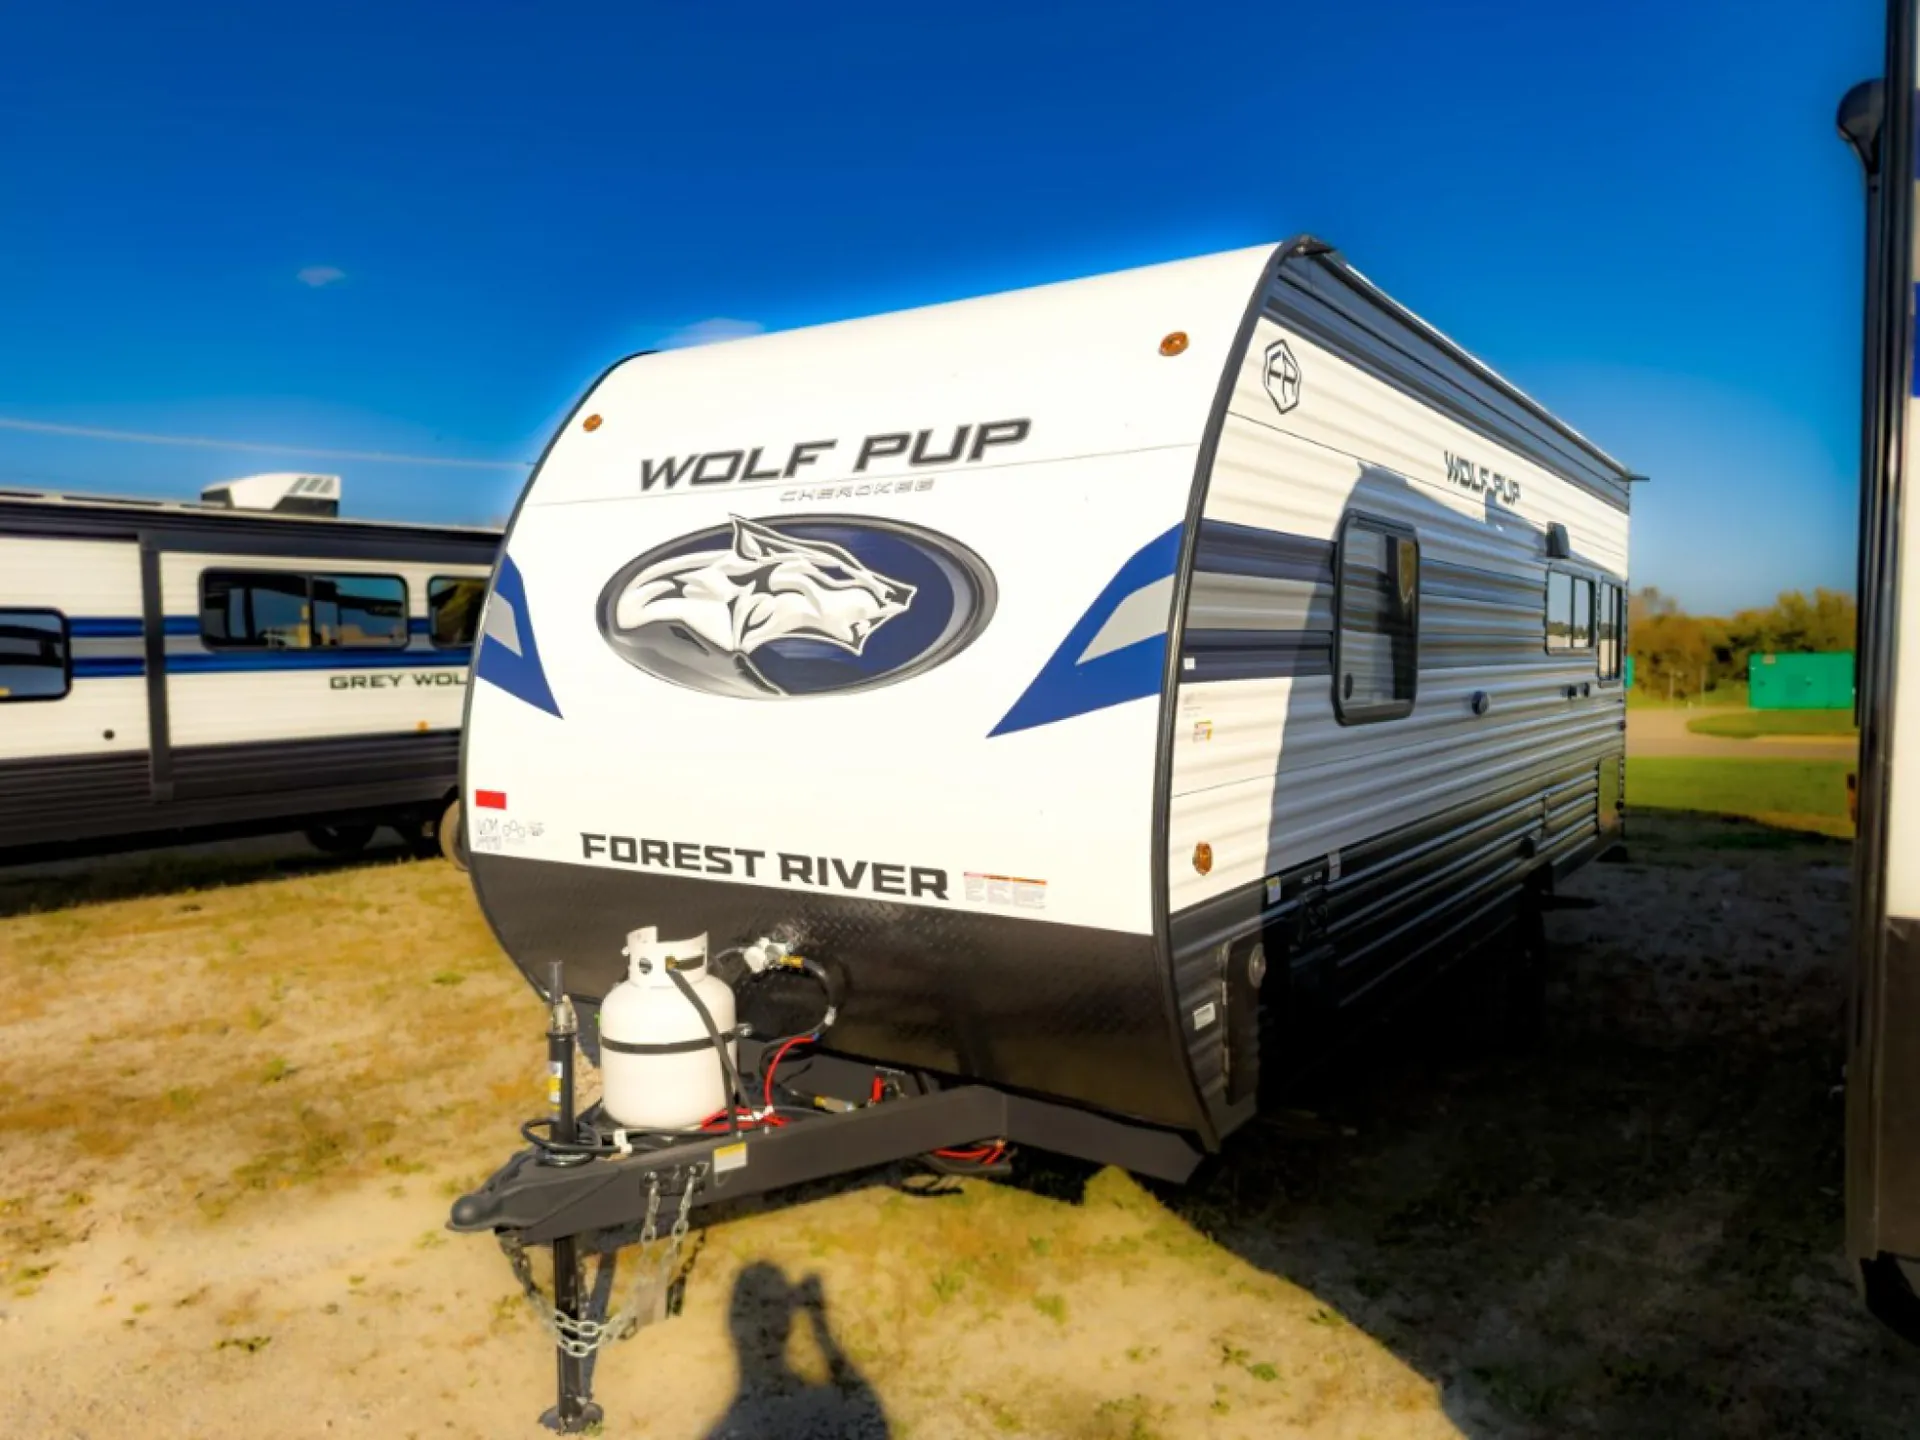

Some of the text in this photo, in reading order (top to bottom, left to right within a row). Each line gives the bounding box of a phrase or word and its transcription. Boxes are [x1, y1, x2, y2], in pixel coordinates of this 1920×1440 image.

[640, 417, 1032, 492] WOLF PUP
[1443, 449, 1522, 506] WOLF PUP
[779, 478, 935, 502] CHEROKEE
[330, 672, 469, 691] GREY WOL
[579, 832, 766, 879] FOREST
[777, 852, 950, 901] RIVER
